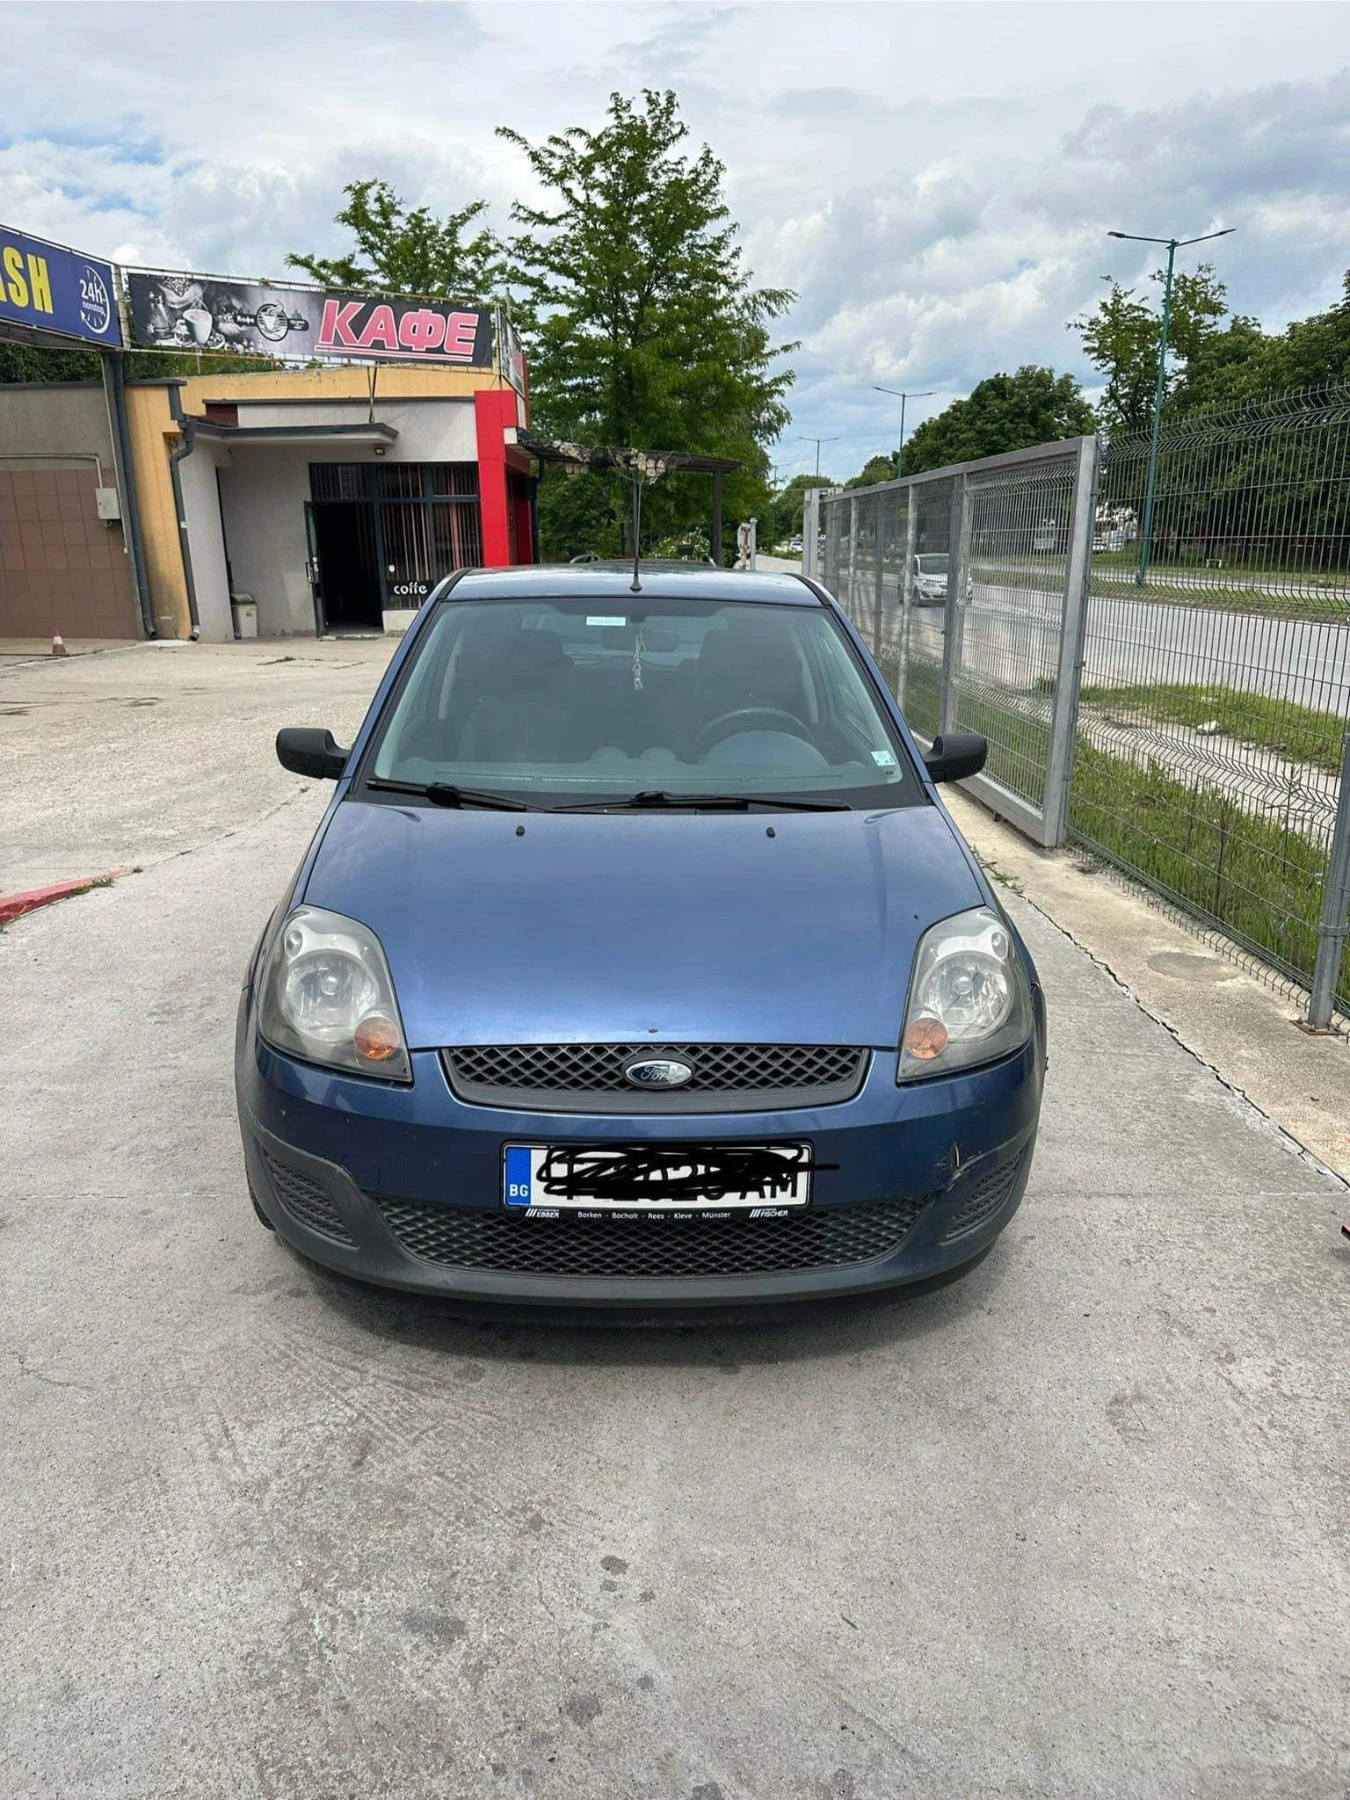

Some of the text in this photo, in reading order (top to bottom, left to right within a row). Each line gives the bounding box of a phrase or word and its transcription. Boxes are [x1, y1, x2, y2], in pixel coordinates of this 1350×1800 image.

[0, 246, 53, 314] SH
[319, 300, 478, 354] КАФЕ
[393, 581, 428, 595] coffe
[509, 1183, 529, 1197] BG
[577, 1211, 603, 1219] Borken
[647, 1212, 665, 1220] Rees
[673, 1212, 693, 1220] Kleve
[701, 1211, 731, 1219] Münster
